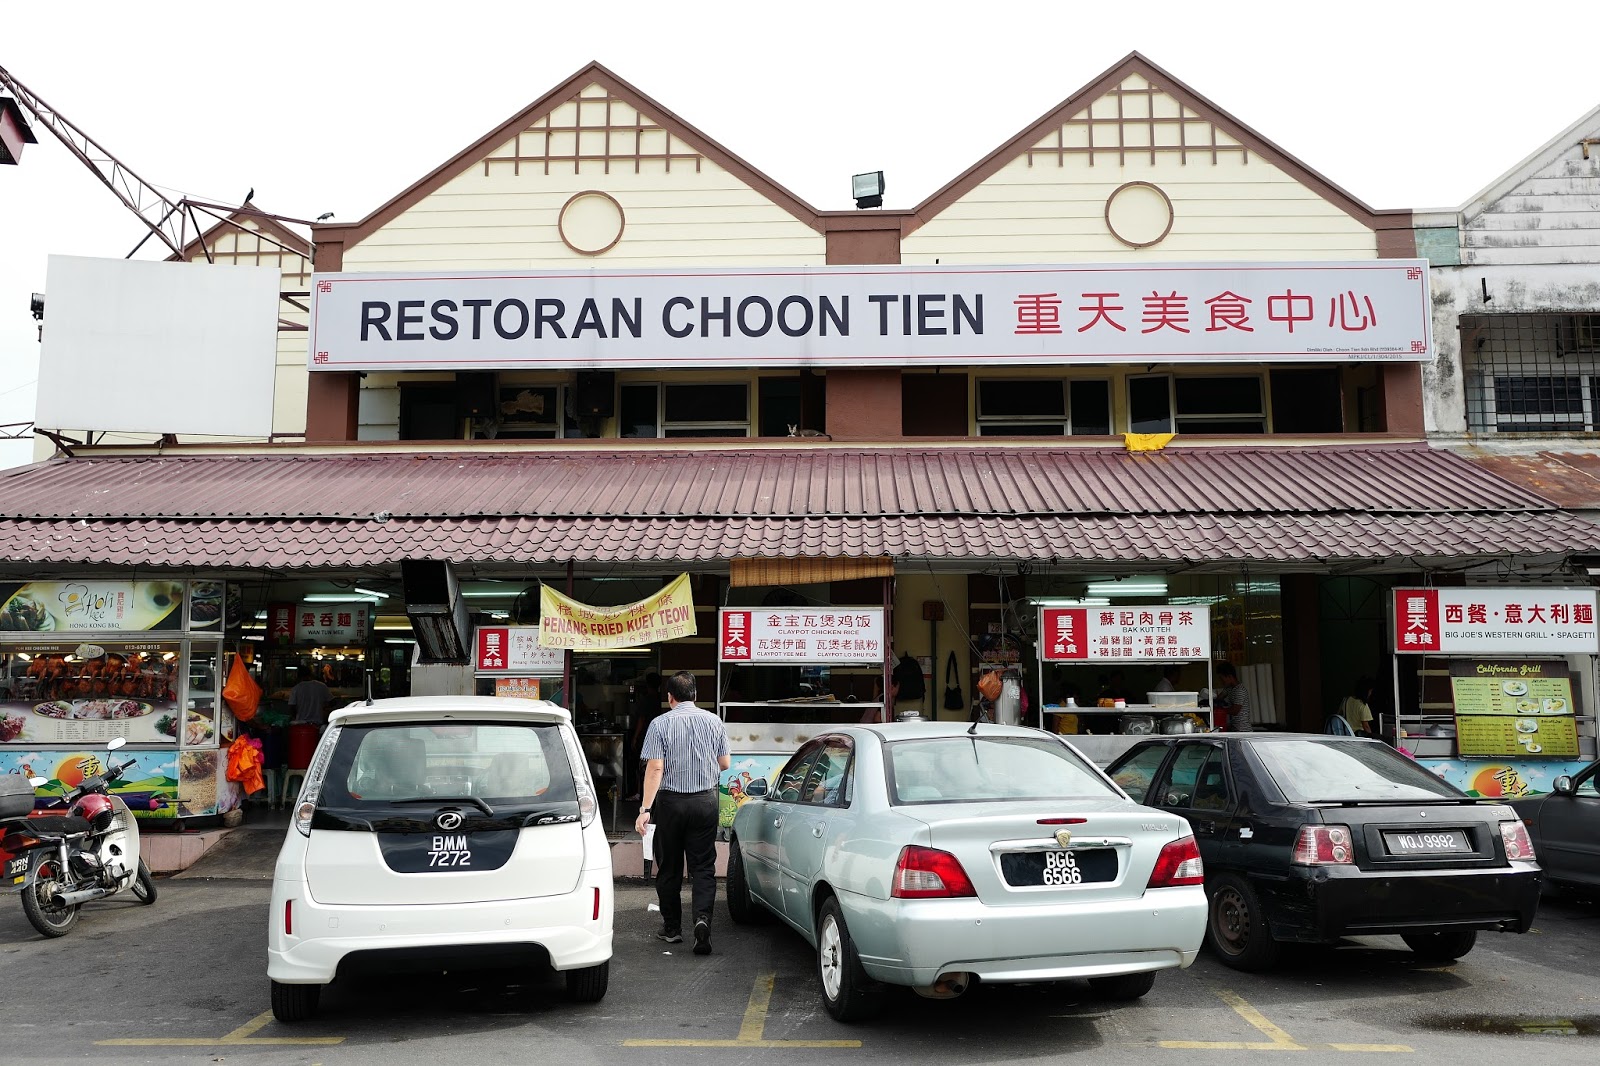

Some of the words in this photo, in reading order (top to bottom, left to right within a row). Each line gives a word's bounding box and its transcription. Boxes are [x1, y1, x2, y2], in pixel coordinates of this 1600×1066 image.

[360, 297, 642, 342] RESTORAN
[662, 295, 850, 339] CHOON
[868, 294, 984, 336] TIEN
[1013, 288, 1377, 335] 重天美食中心
[276, 608, 289, 631] 重天
[543, 617, 587, 636] PENANG
[590, 621, 624, 636] FRIED
[626, 612, 656, 633] KUEY
[658, 605, 690, 626] TEOW
[766, 614, 871, 628] 金宝瓦煲鸡饭
[1099, 611, 1194, 626] 蘇記肉骨茶
[1406, 597, 1429, 631] 重天
[728, 613, 746, 645] 重天
[1056, 615, 1074, 643] 重天
[1445, 631, 1459, 639] BIG
[1461, 631, 1483, 639] JOE'S
[1484, 631, 1523, 639] WESTERN
[1525, 631, 1548, 639] GRILL
[1557, 631, 1595, 639] SPAGETTI
[486, 633, 501, 657] 重天
[757, 638, 807, 650] 瓦煲伊面
[816, 638, 879, 652] 瓦煲老鼠粉
[1404, 631, 1433, 645] 美食
[724, 645, 749, 657] 美食
[1054, 643, 1078, 654] 美食
[483, 657, 503, 667] 美食
[1476, 664, 1518, 675] California
[1520, 664, 1541, 675] Grill
[537, 814, 577, 825] ALZA
[1141, 823, 1169, 832] WAJA
[433, 835, 468, 852] BMM
[1398, 835, 1424, 849] WQJ
[1425, 834, 1456, 848] 9992
[11, 856, 29, 868] WRN
[428, 851, 471, 867] 7272
[1045, 851, 1076, 869] BGG
[10, 864, 28, 875] 440
[1043, 867, 1082, 885] 6566
